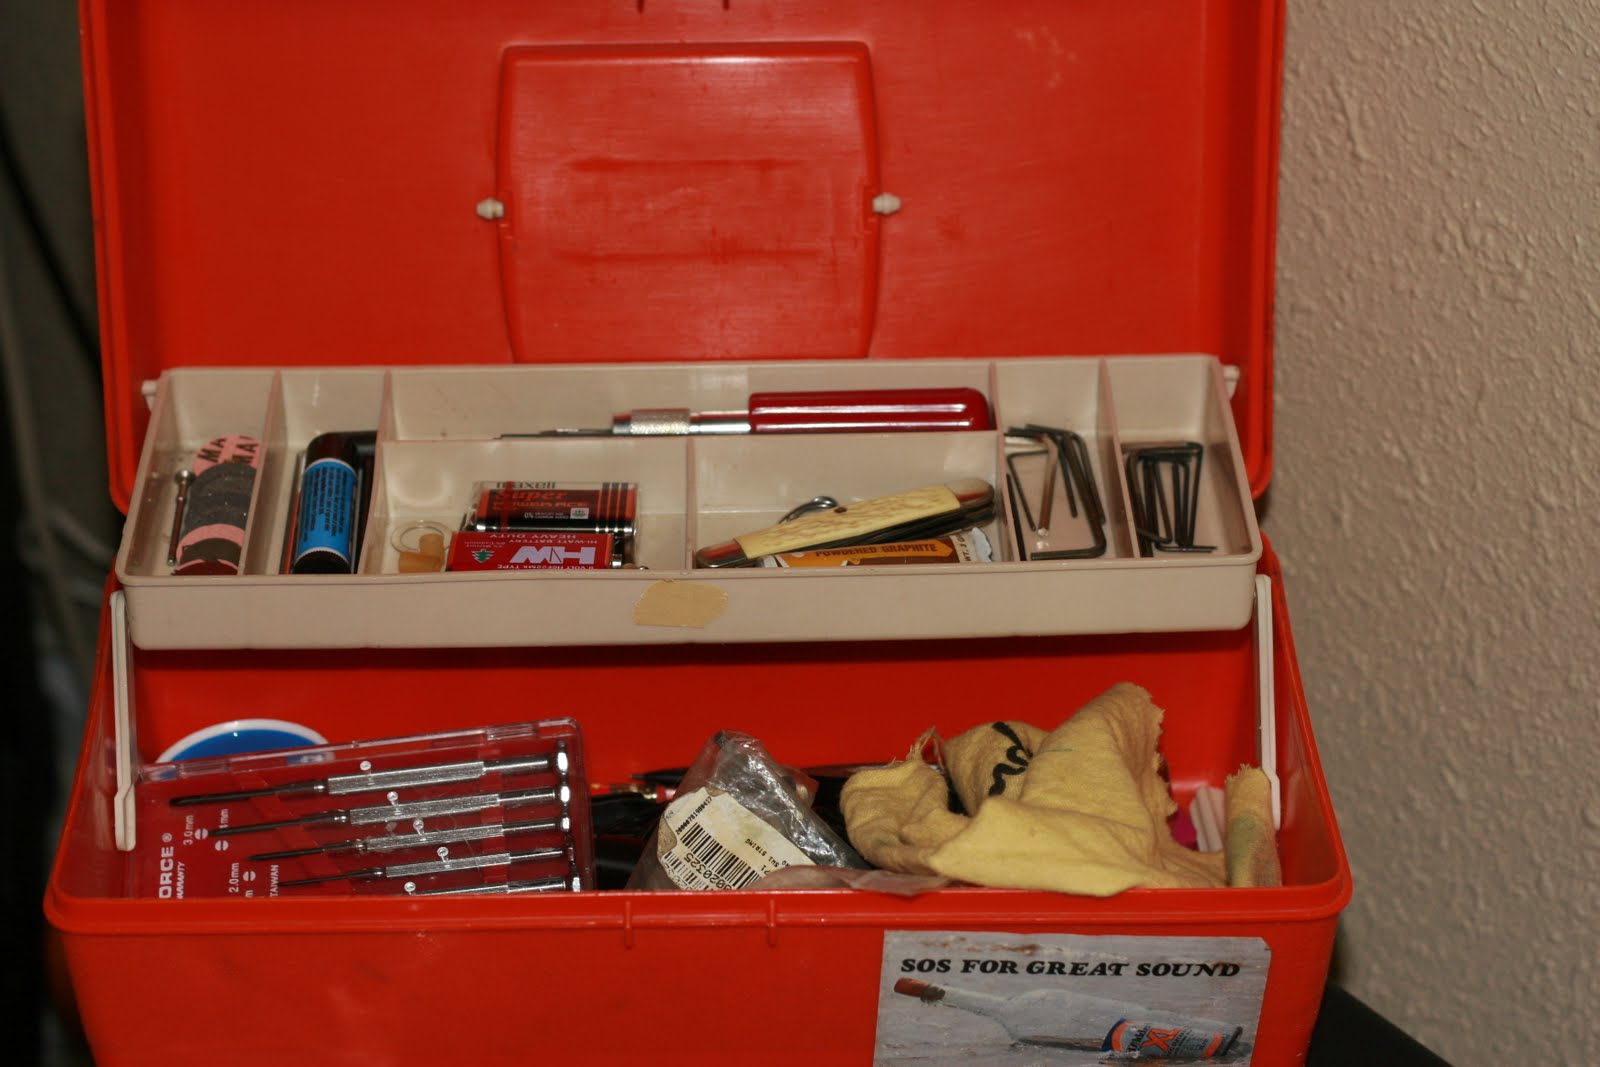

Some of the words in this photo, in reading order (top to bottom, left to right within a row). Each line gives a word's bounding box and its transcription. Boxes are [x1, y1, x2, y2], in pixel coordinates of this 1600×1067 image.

[509, 546, 596, 564] HW
[815, 546, 876, 556] POWDERED
[881, 543, 937, 552] GRAPHITE
[183, 815, 194, 846] 3.0mm
[744, 838, 768, 857] STRING
[228, 862, 240, 893] 2.0mm
[269, 864, 279, 898] TAIWAN
[901, 958, 951, 973] SOS
[960, 959, 1019, 974] FOR
[1026, 960, 1130, 976] GREAT
[1136, 962, 1240, 977] SOUND
